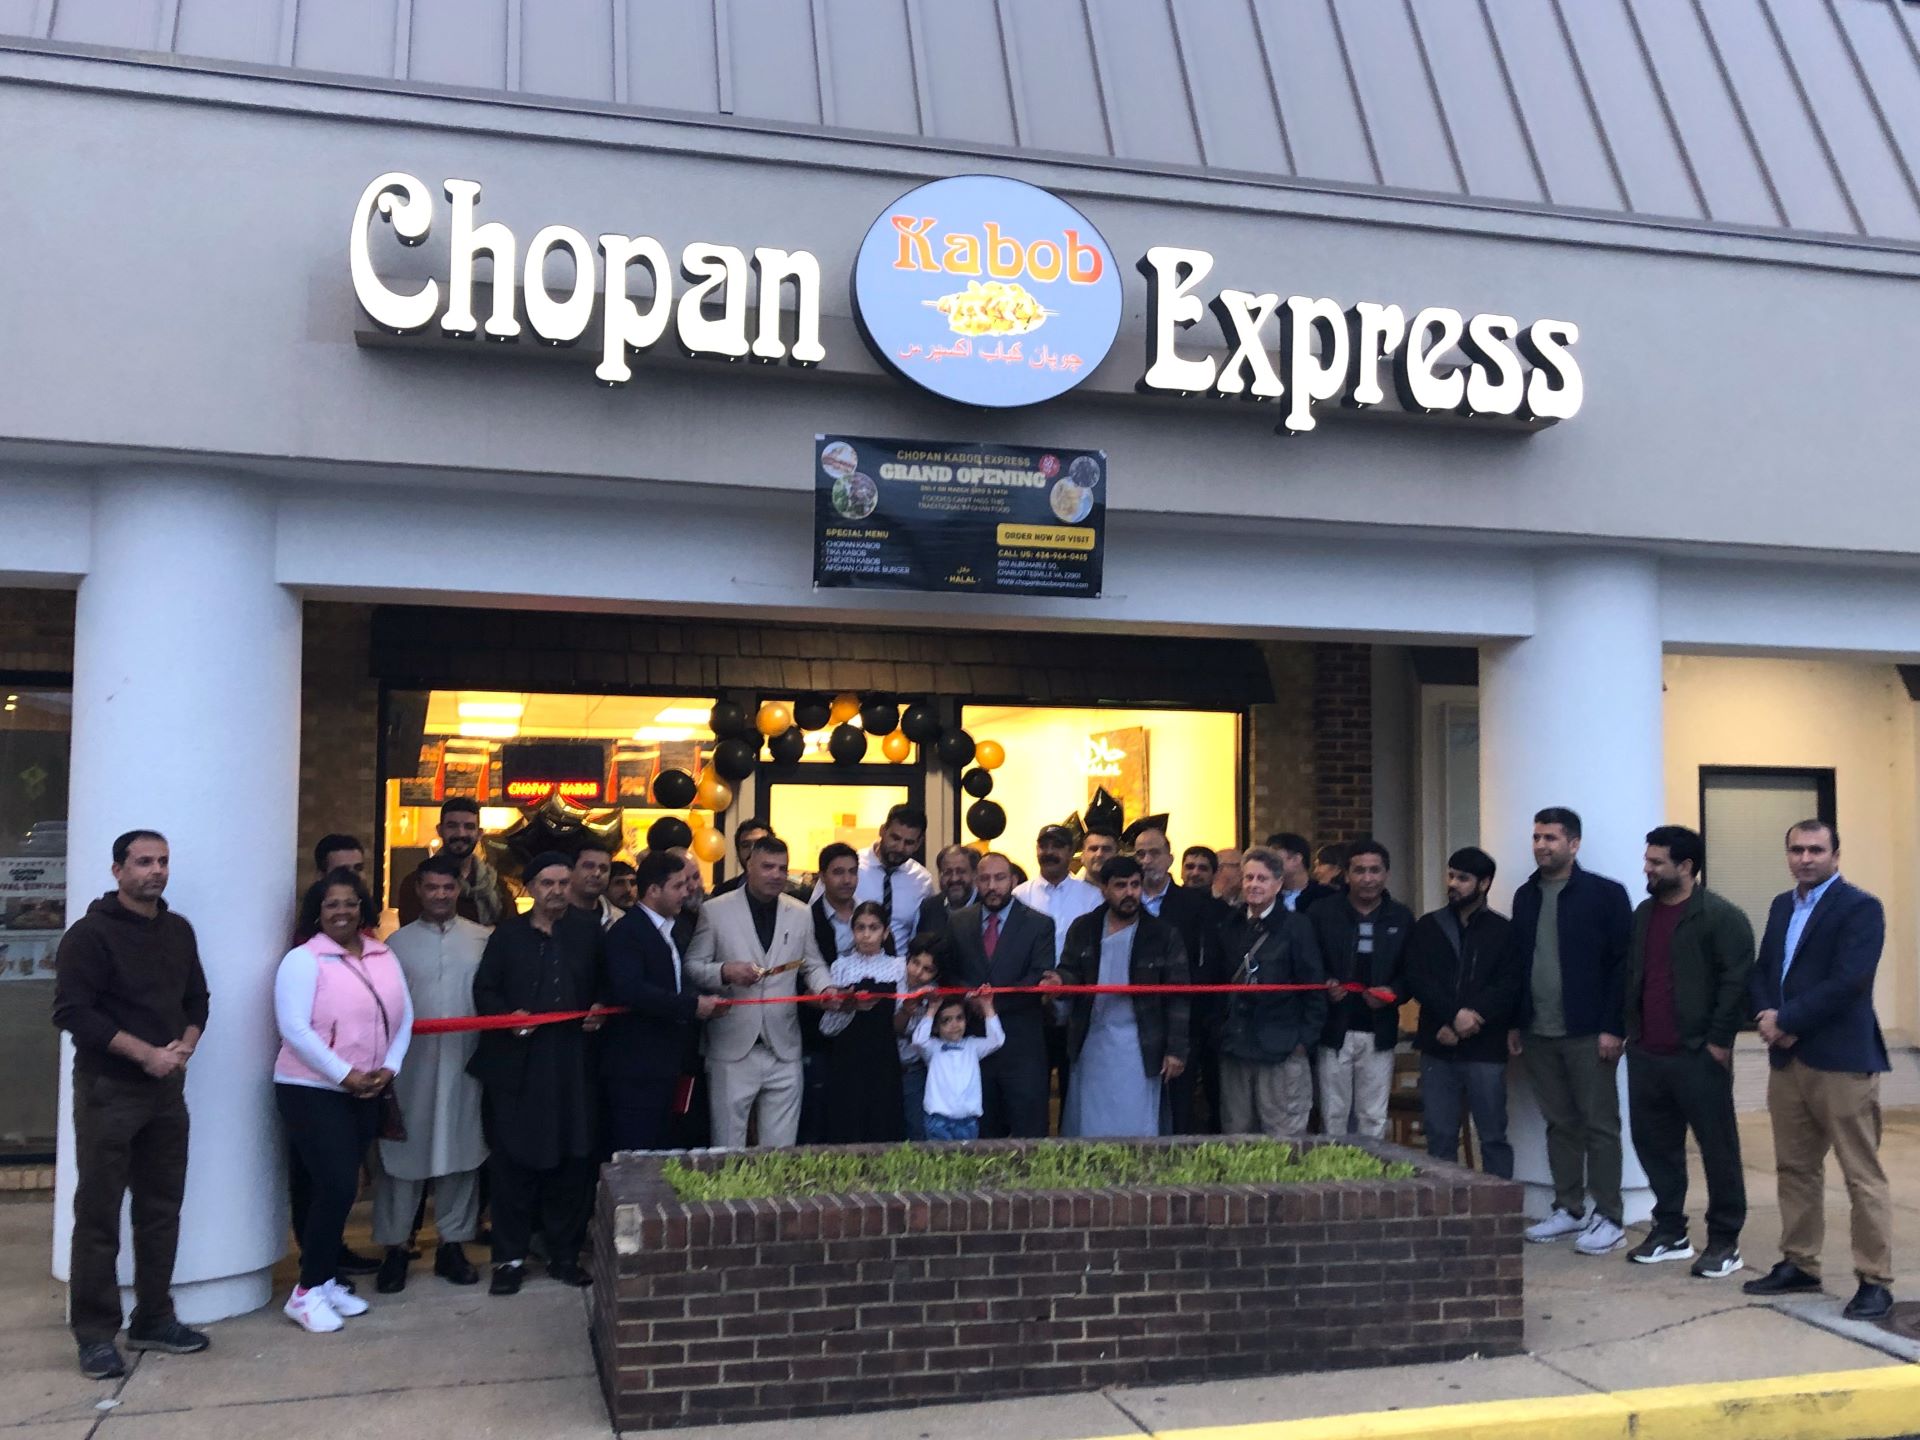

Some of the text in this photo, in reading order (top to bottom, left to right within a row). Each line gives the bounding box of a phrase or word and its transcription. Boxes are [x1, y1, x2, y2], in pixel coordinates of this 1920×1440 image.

[891, 214, 1104, 285] Kabob
[350, 172, 826, 382] Chopan
[1143, 246, 1584, 432] Express
[897, 449, 942, 462] CHOPAN
[943, 452, 982, 465] KABOB
[983, 454, 1031, 467] EXPRESS
[879, 463, 1047, 488] GRAND OPENING
[826, 528, 889, 539] SPECIAL MENU
[1005, 531, 1090, 543] ORDER NOW OR VISIT
[826, 540, 881, 549] CHOPAN KABOB
[998, 549, 1018, 558] CALL
[1020, 550, 1033, 559] US:
[826, 556, 881, 565] CHICKEN KABOB
[1010, 561, 1046, 569] ALBEMARLE
[824, 564, 910, 574] AFGHAN CUISINE BURGER
[997, 569, 1052, 578] CHARLOTTESVILLE
[949, 575, 976, 584] HALAL
[558, 782, 597, 796] KABOB
